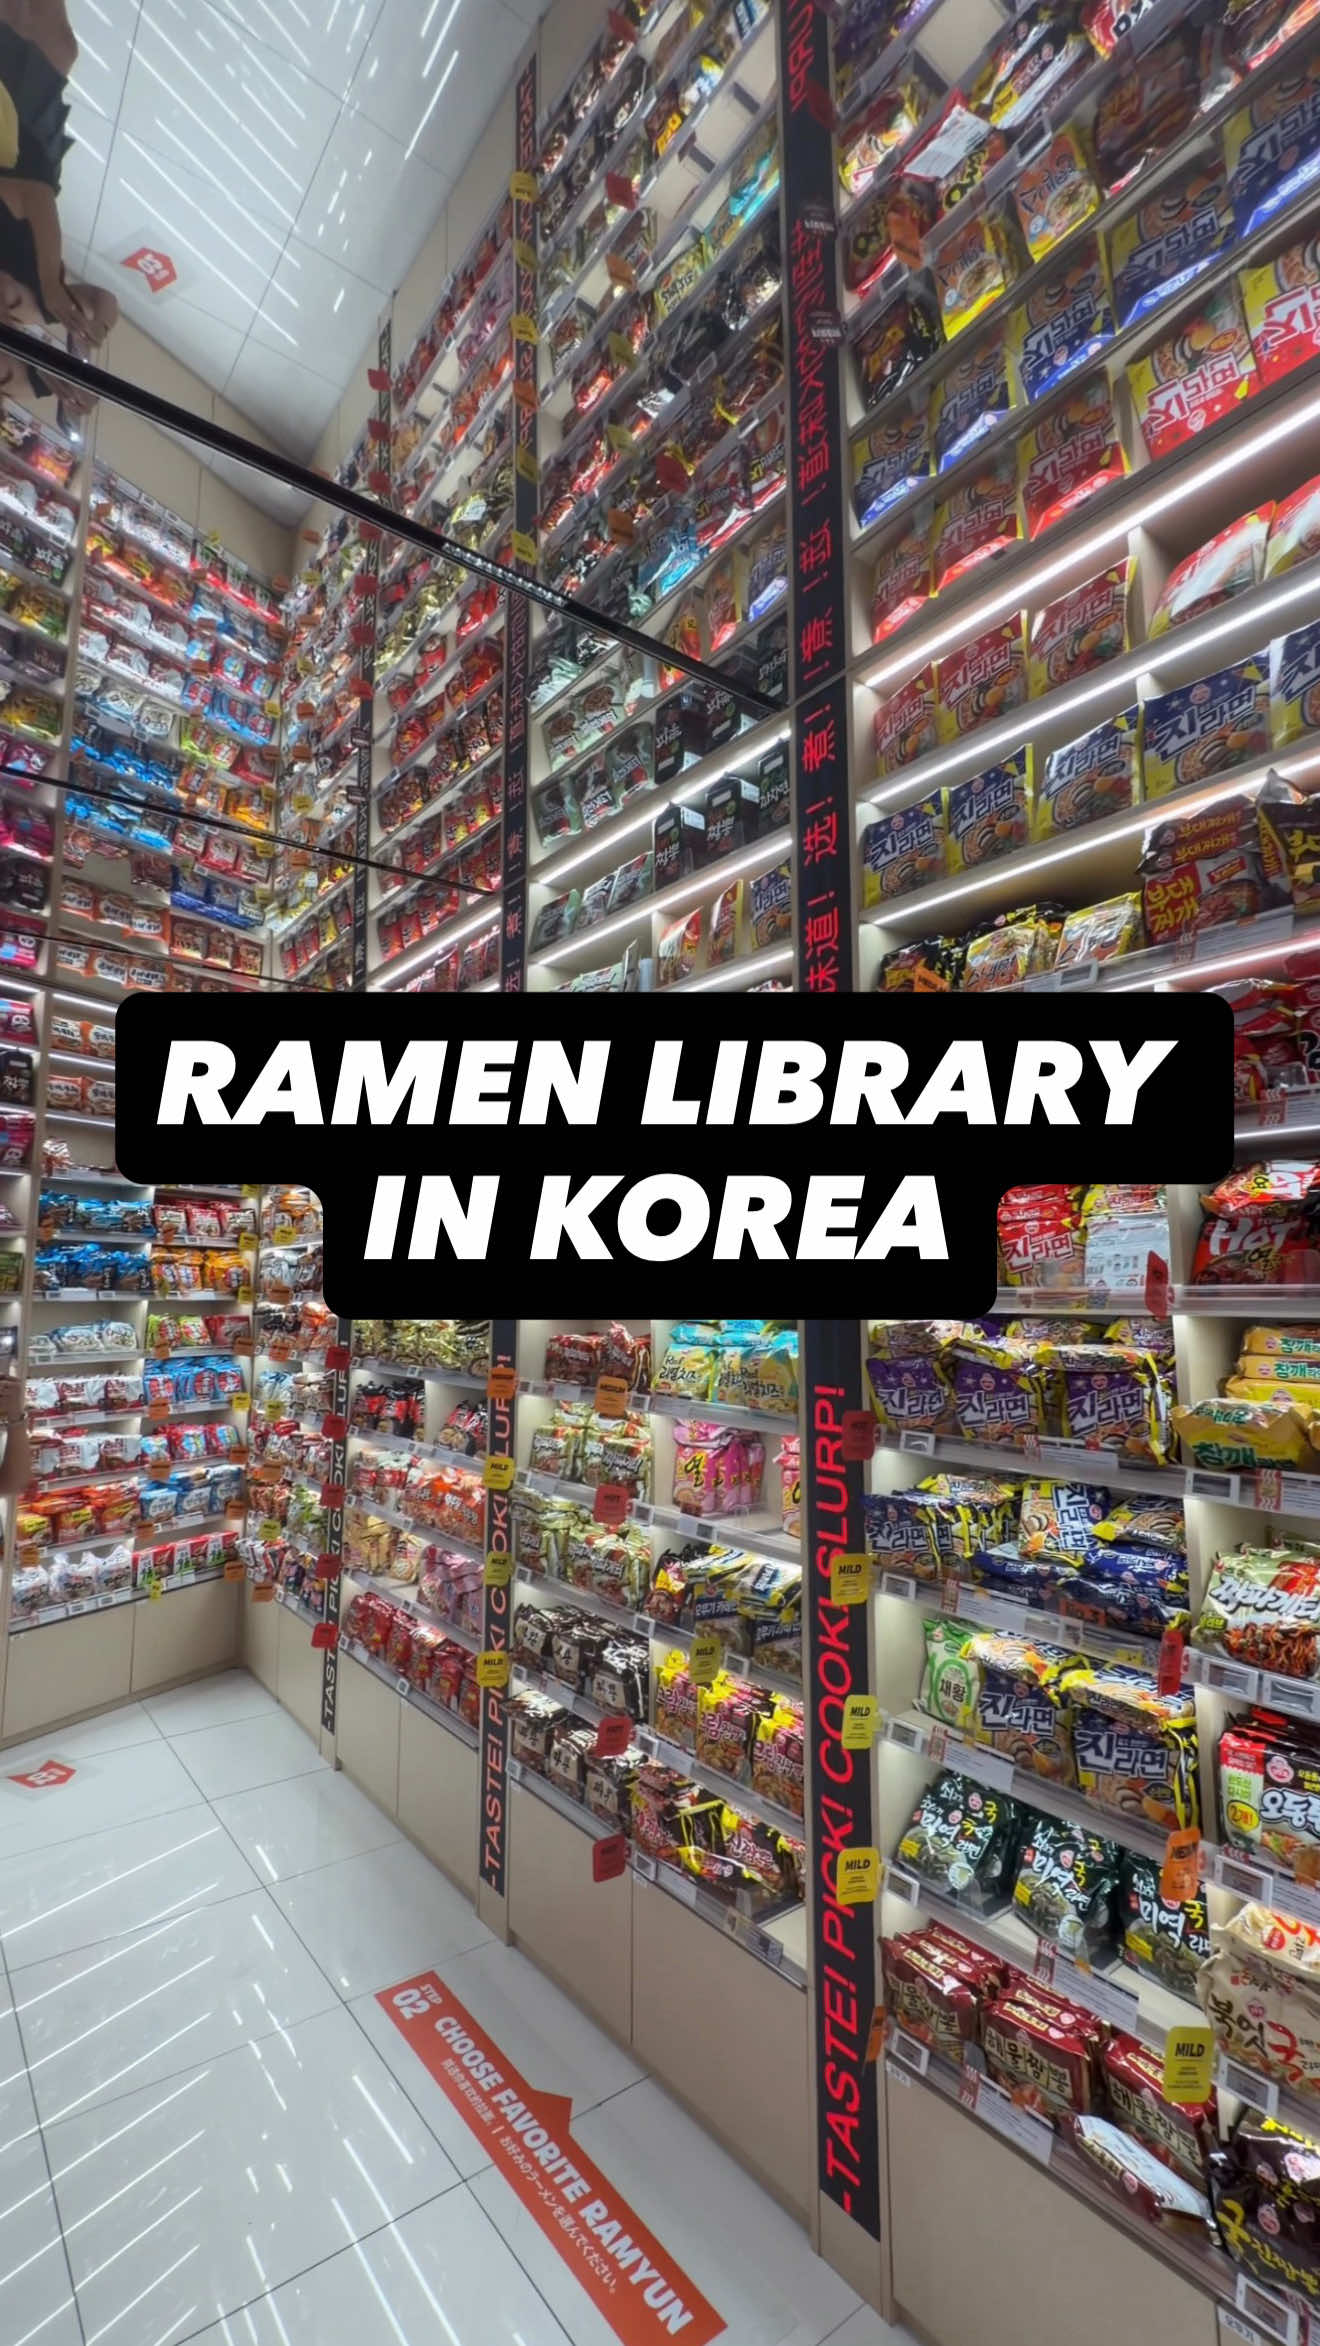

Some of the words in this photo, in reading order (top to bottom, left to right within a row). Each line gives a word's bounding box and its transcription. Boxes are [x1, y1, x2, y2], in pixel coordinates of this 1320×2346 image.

[941, 641, 1011, 707] 진라면
[1153, 685, 1256, 765] 진라면
[950, 777, 1014, 841] 진라면
[868, 817, 934, 874] 진라면
[1147, 876, 1196, 911] 부대
[1154, 896, 1200, 934] 찌개
[1001, 1232, 1075, 1274] 진라면
[956, 1390, 1030, 1430] 진라면
[1067, 1388, 1146, 1440] 진라면
[838, 1564, 862, 1575] MILD
[483, 1658, 504, 1666] MILD
[939, 1679, 966, 1703] 채황
[850, 1706, 871, 1717] MILD
[978, 1690, 1056, 1737] 진라면
[1074, 1730, 1169, 1780] 진라면
[844, 1859, 871, 1870] MILD
[392, 1988, 430, 2020] 02
[420, 1983, 443, 2005] STEP
[985, 2027, 1072, 2096] 해물짬뽕
[1175, 2043, 1205, 2057] MILD
[434, 2016, 504, 2092] CHOOSE
[491, 2088, 593, 2204] FAVORITE
[578, 2199, 694, 2336] RAMYUN
